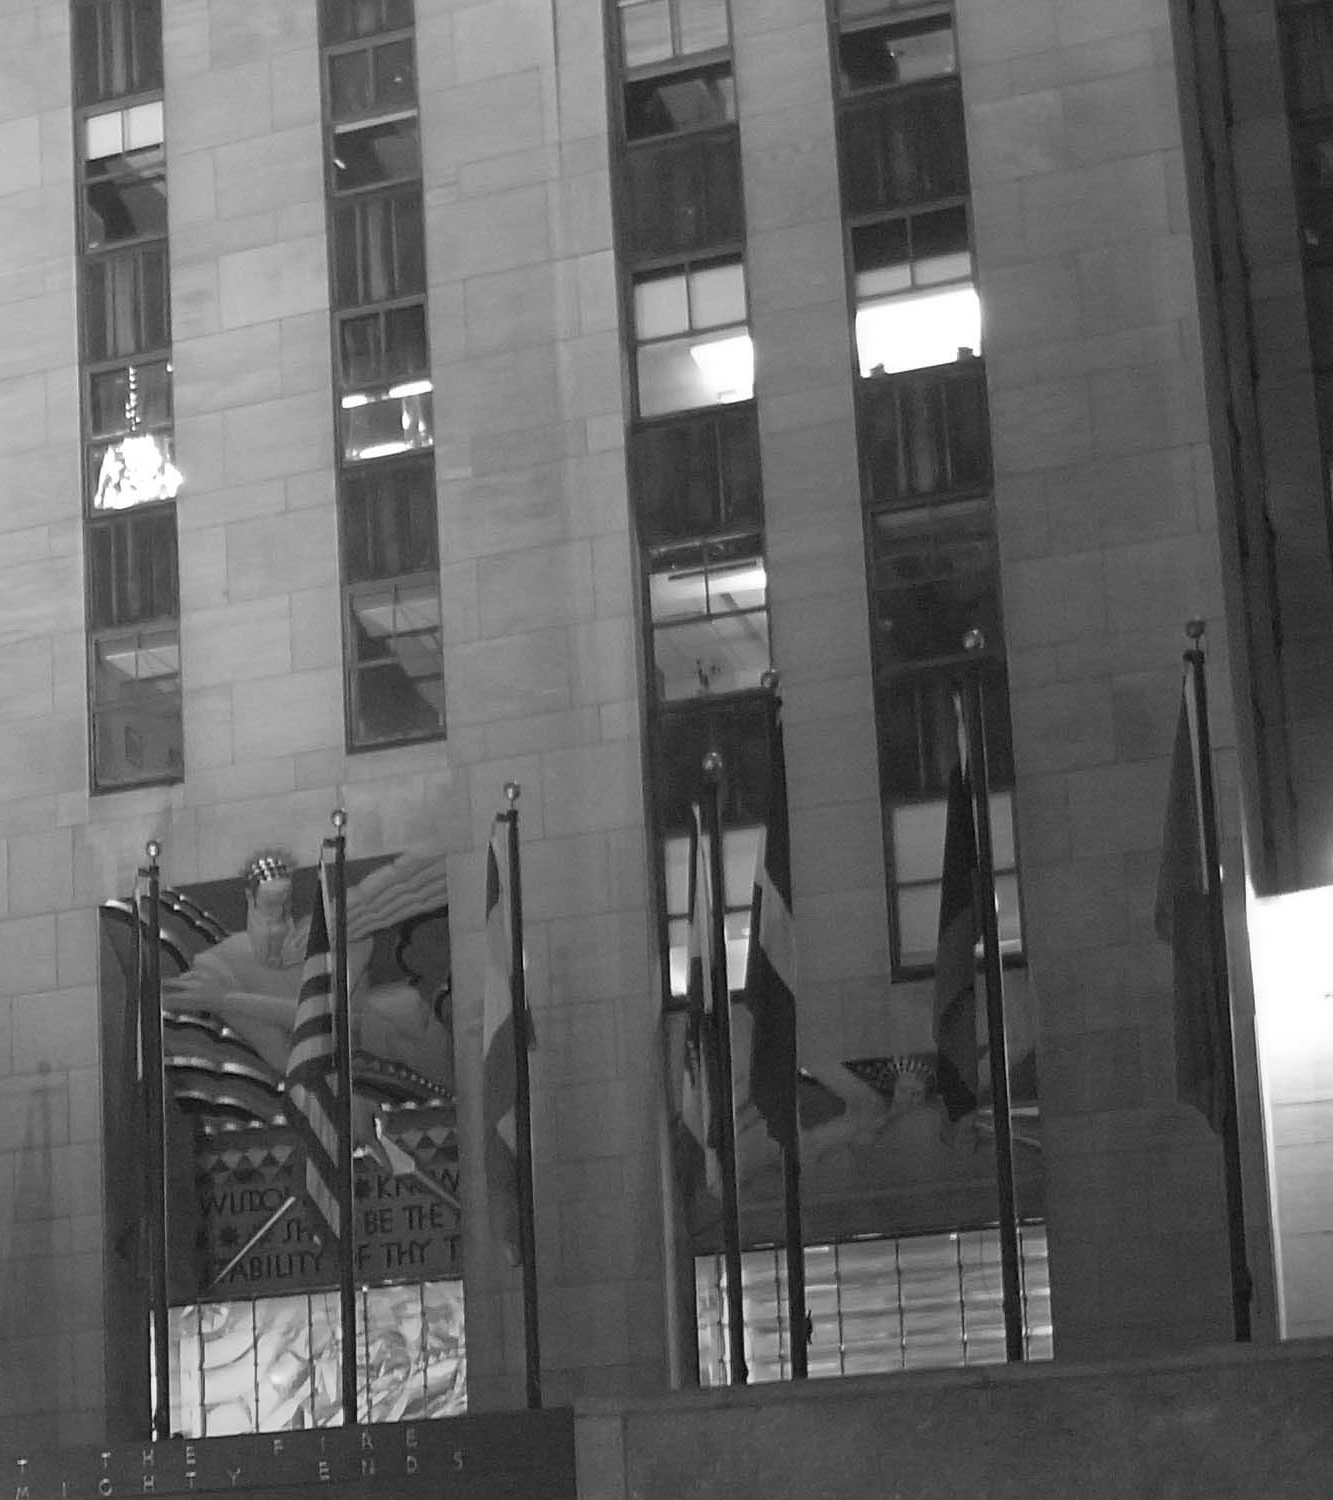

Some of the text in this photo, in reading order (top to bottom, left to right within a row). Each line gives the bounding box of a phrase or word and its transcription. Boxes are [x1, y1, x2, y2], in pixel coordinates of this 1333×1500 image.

[365, 1204, 444, 1235] BE THE
[381, 1239, 432, 1268] THY
[101, 1446, 196, 1469] THE
[15, 1467, 241, 1500] MIGHTY
[319, 1451, 463, 1481] ENDS
